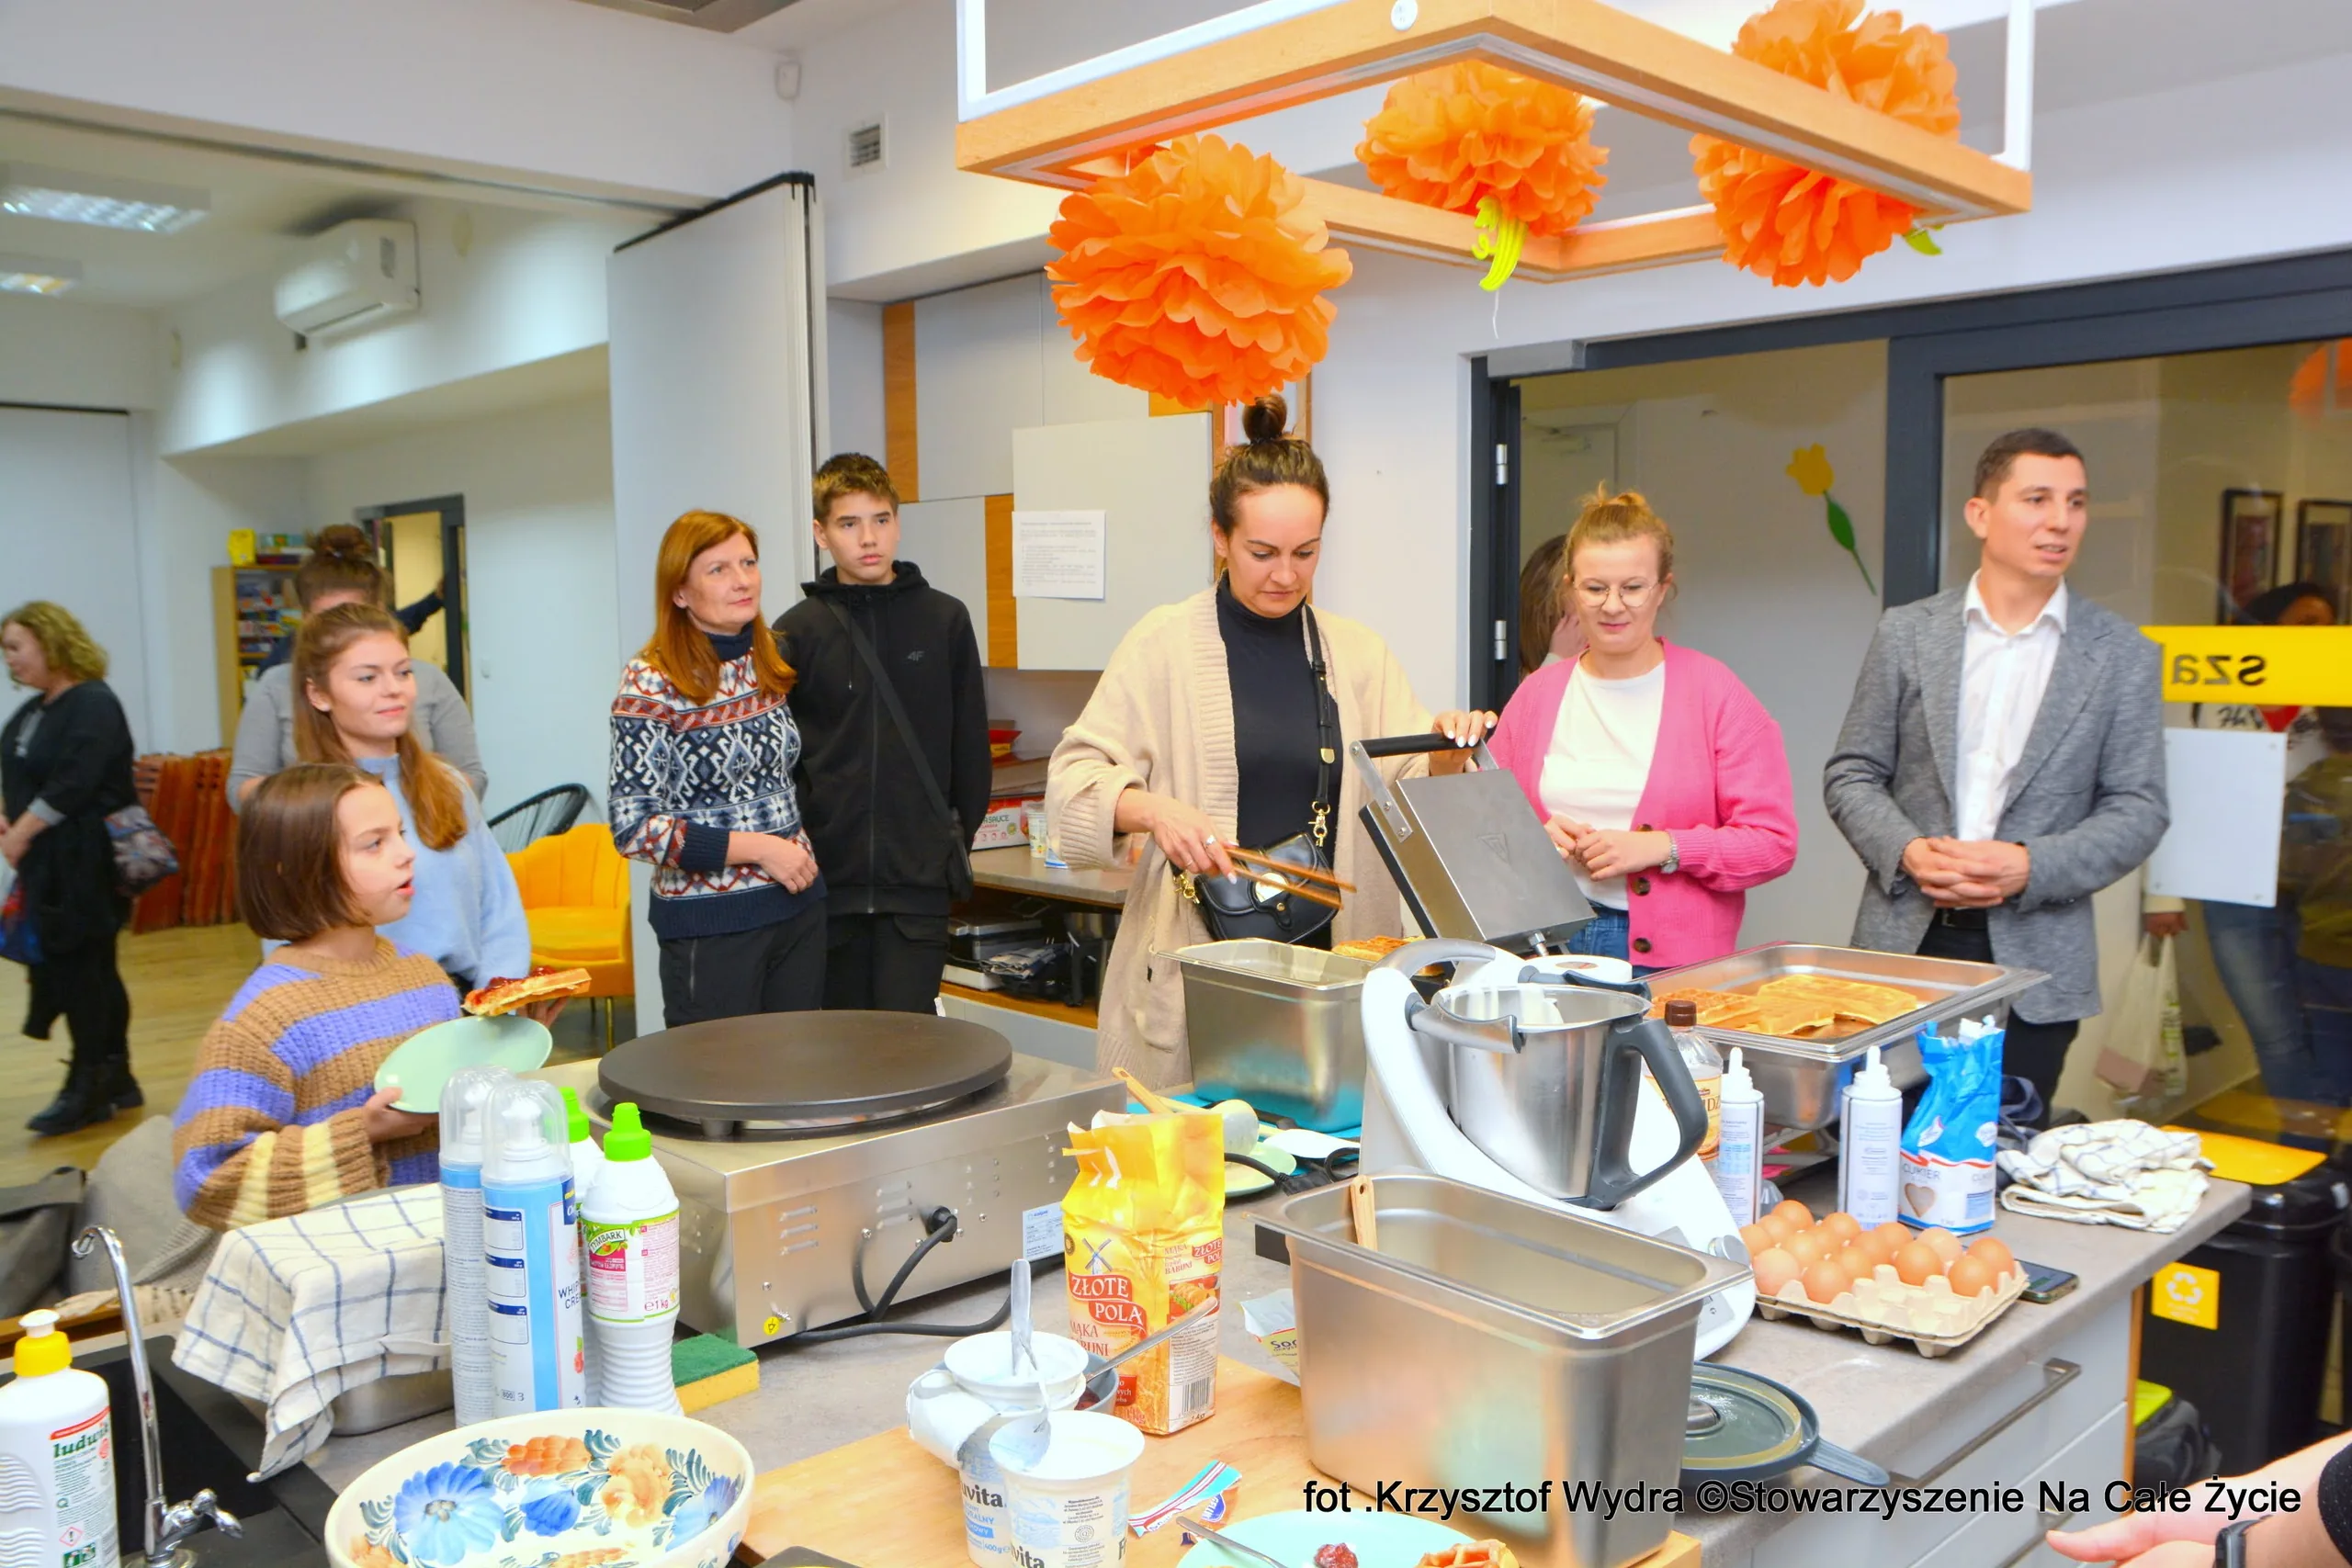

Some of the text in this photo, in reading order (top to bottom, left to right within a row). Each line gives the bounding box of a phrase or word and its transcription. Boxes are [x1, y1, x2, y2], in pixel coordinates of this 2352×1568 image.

[989, 815, 1010, 824] SAUCE
[1194, 1240, 1221, 1258] ZŁOTE
[1071, 1276, 1129, 1298] ZŁOTE
[565, 1293, 582, 1309] CRE
[1095, 1303, 1144, 1325] POLA
